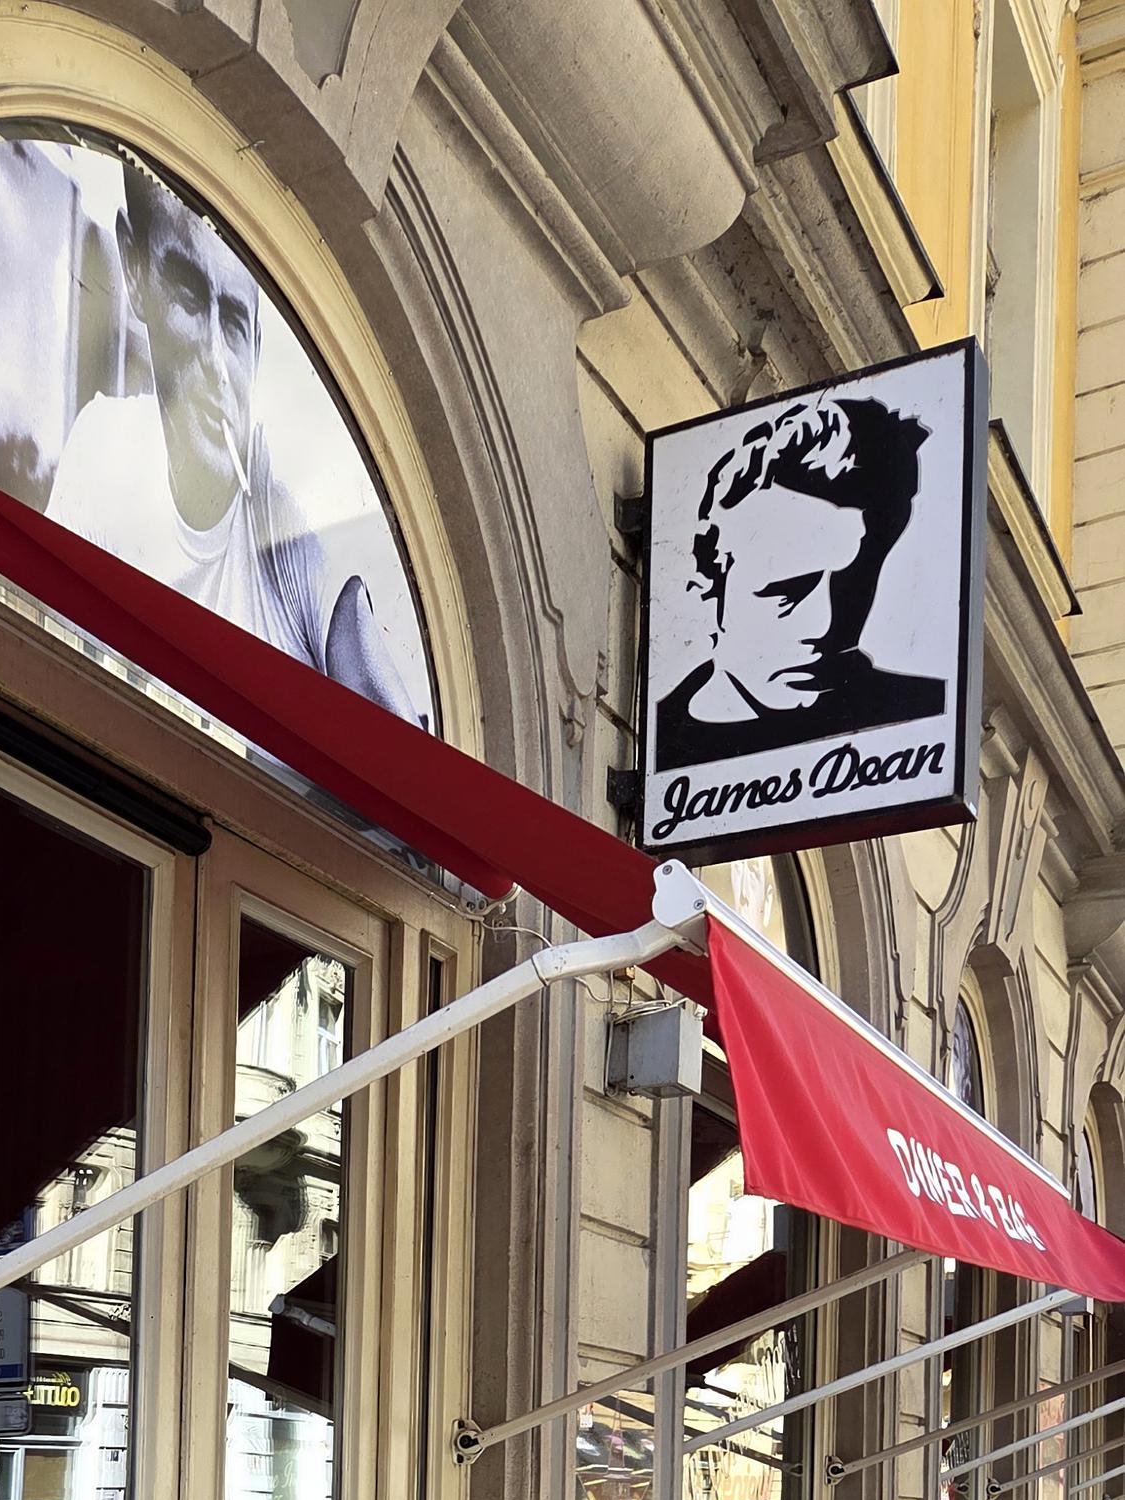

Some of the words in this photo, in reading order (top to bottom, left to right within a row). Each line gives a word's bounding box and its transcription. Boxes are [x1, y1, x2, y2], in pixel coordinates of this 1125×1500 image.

[651, 768, 802, 840] James
[809, 741, 943, 799] Dean
[887, 1128, 981, 1219] DINER
[988, 1184, 1047, 1251] BAR
